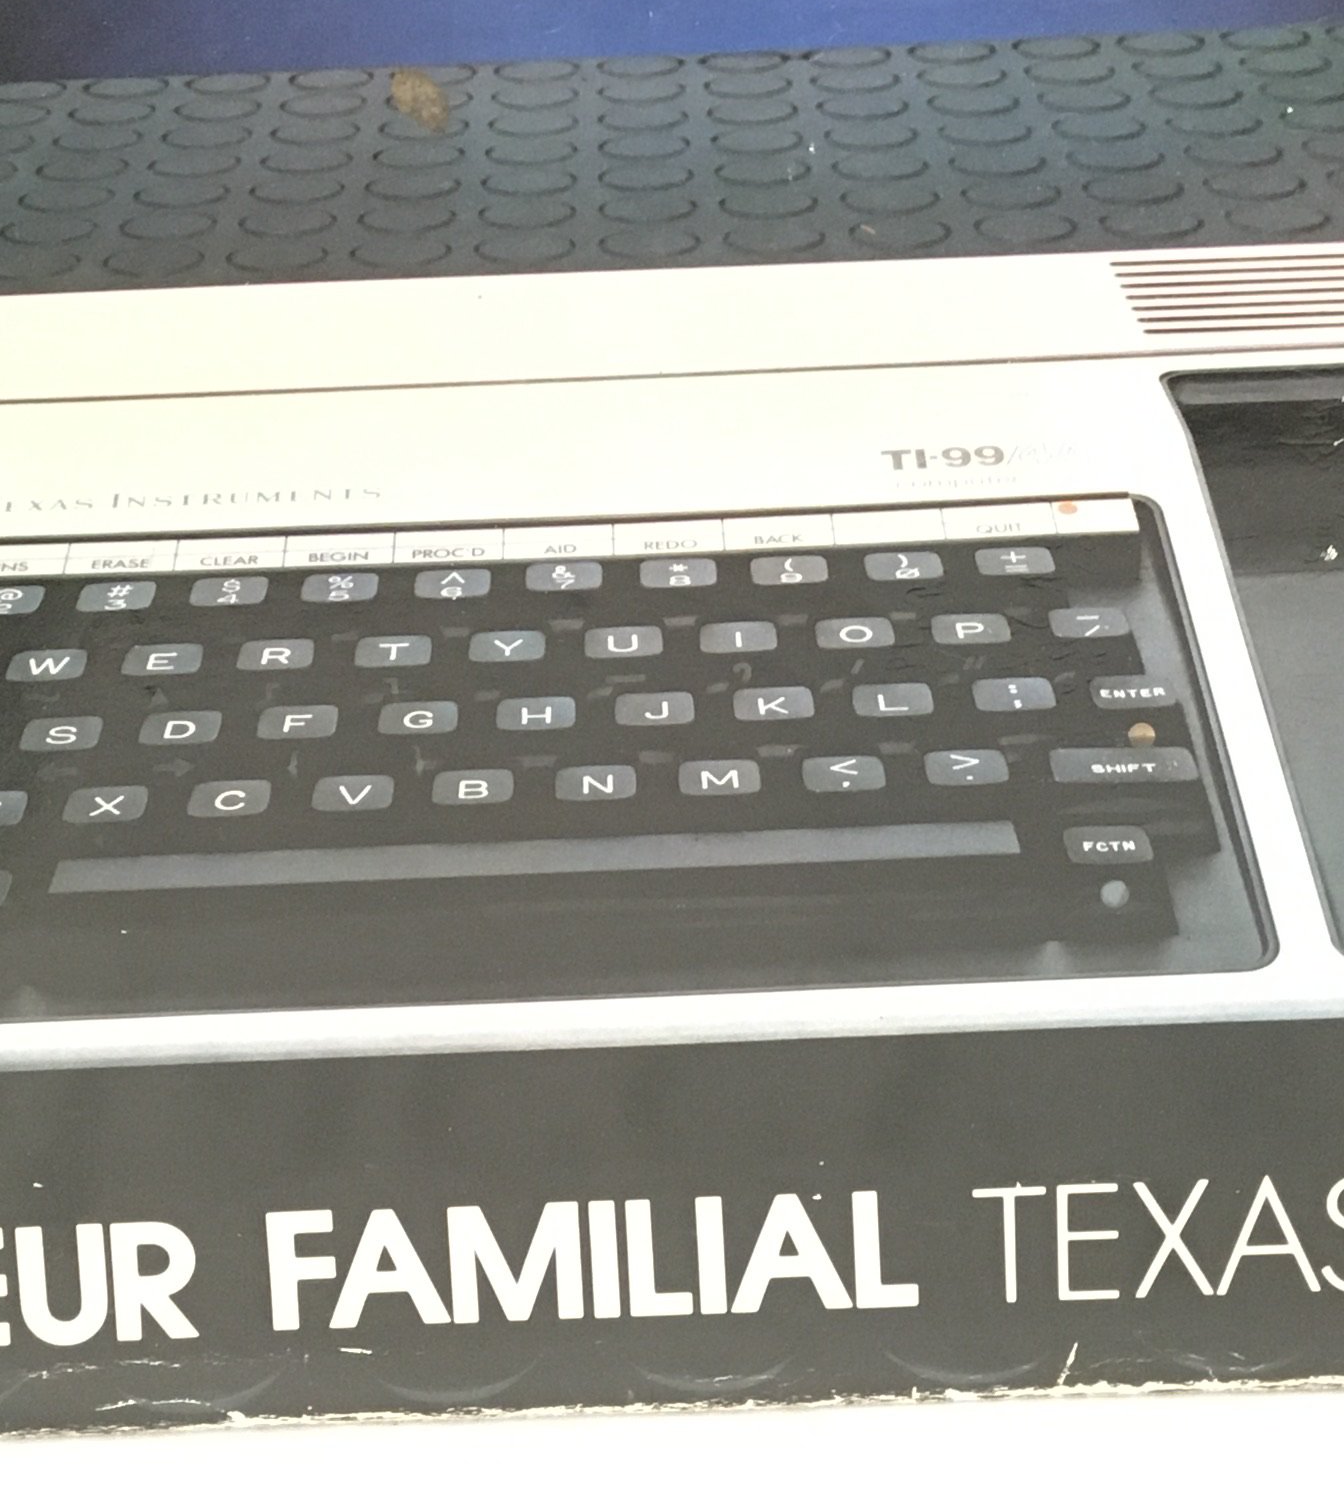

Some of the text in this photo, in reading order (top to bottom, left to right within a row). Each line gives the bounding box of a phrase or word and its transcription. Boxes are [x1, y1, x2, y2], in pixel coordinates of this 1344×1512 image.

[112, 488, 383, 510] INSTRUMENTS
[91, 558, 150, 571] ERASE
[200, 555, 259, 568] CLEAR
[308, 550, 369, 564] BEGIN
[544, 543, 577, 555] AID
[644, 538, 698, 551] REDO
[754, 533, 803, 545] BACK
[976, 522, 1022, 535] QUIT
[104, 599, 127, 611] 3
[216, 593, 239, 604] 4
[327, 590, 351, 602] 5
[28, 656, 71, 676] W
[145, 652, 178, 671] E
[260, 647, 292, 666] R
[379, 642, 410, 661] T
[494, 638, 524, 657] Y
[607, 634, 638, 652] U
[735, 631, 743, 648] I
[839, 625, 873, 643] O
[955, 622, 985, 639] P
[45, 725, 78, 745] S
[162, 720, 197, 739] D
[282, 714, 313, 733] F
[402, 710, 434, 729] G
[520, 705, 552, 725] H
[645, 701, 670, 719] J
[757, 697, 790, 715] K
[877, 693, 910, 711] L
[1099, 687, 1166, 699] ENTER
[89, 795, 125, 816] X
[214, 790, 246, 811] C
[339, 785, 372, 805] V
[458, 780, 490, 800] B
[582, 774, 614, 794] N
[700, 770, 740, 790] M
[1090, 763, 1156, 774] SHIFT
[1082, 840, 1137, 851] FCTN
[265, 1190, 919, 1331] FAMILIAL
